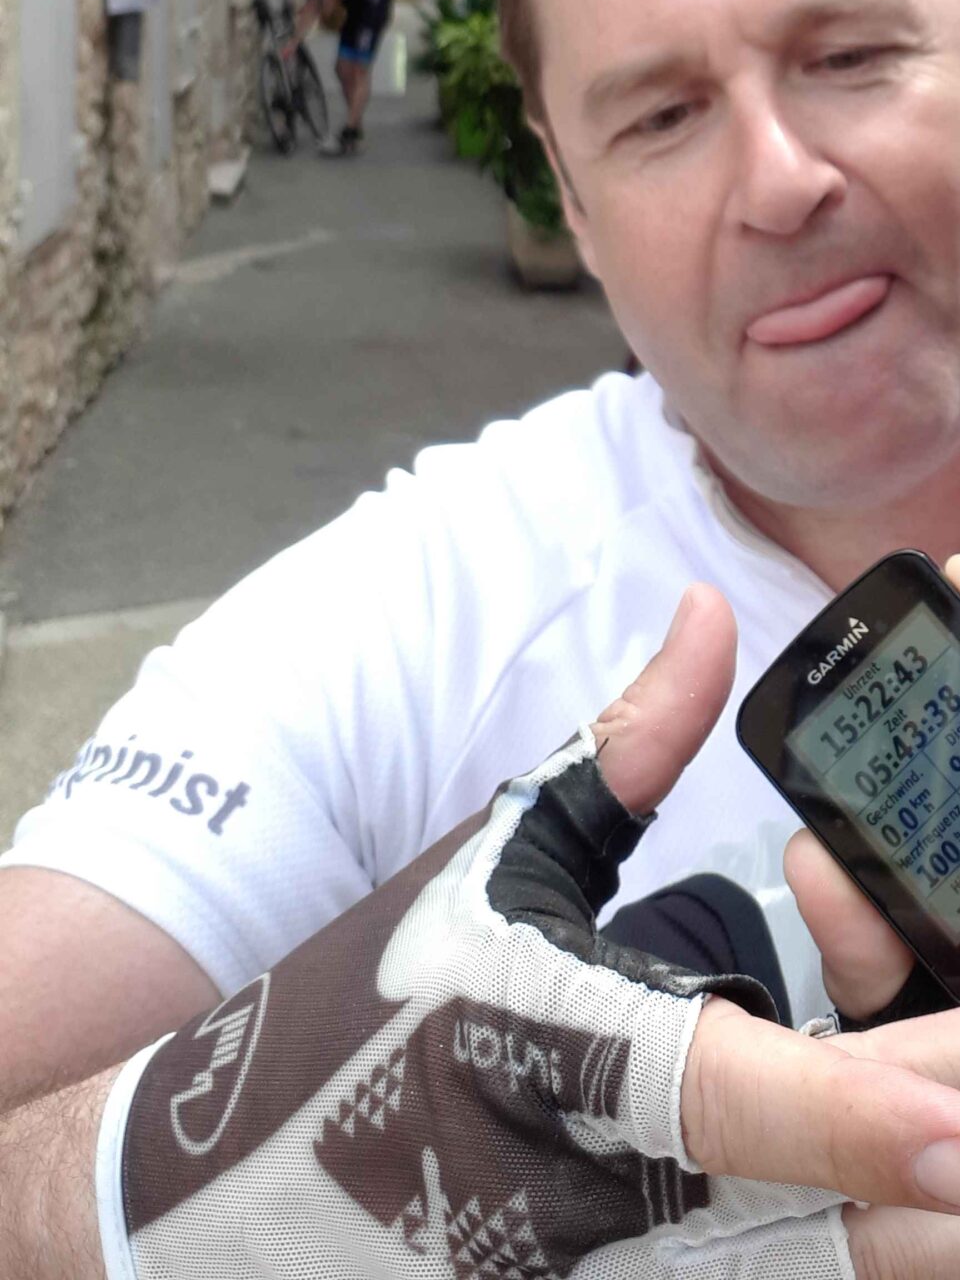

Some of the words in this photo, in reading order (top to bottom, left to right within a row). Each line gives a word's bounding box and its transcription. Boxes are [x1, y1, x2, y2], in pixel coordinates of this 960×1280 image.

[807, 618, 869, 685] GARMIN
[819, 646, 928, 758] 15:22:43
[842, 661, 881, 700] Uhrzeit
[883, 708, 908, 733] Zeit
[865, 769, 924, 827] Geschwind.
[880, 806, 920, 848] 0.0
